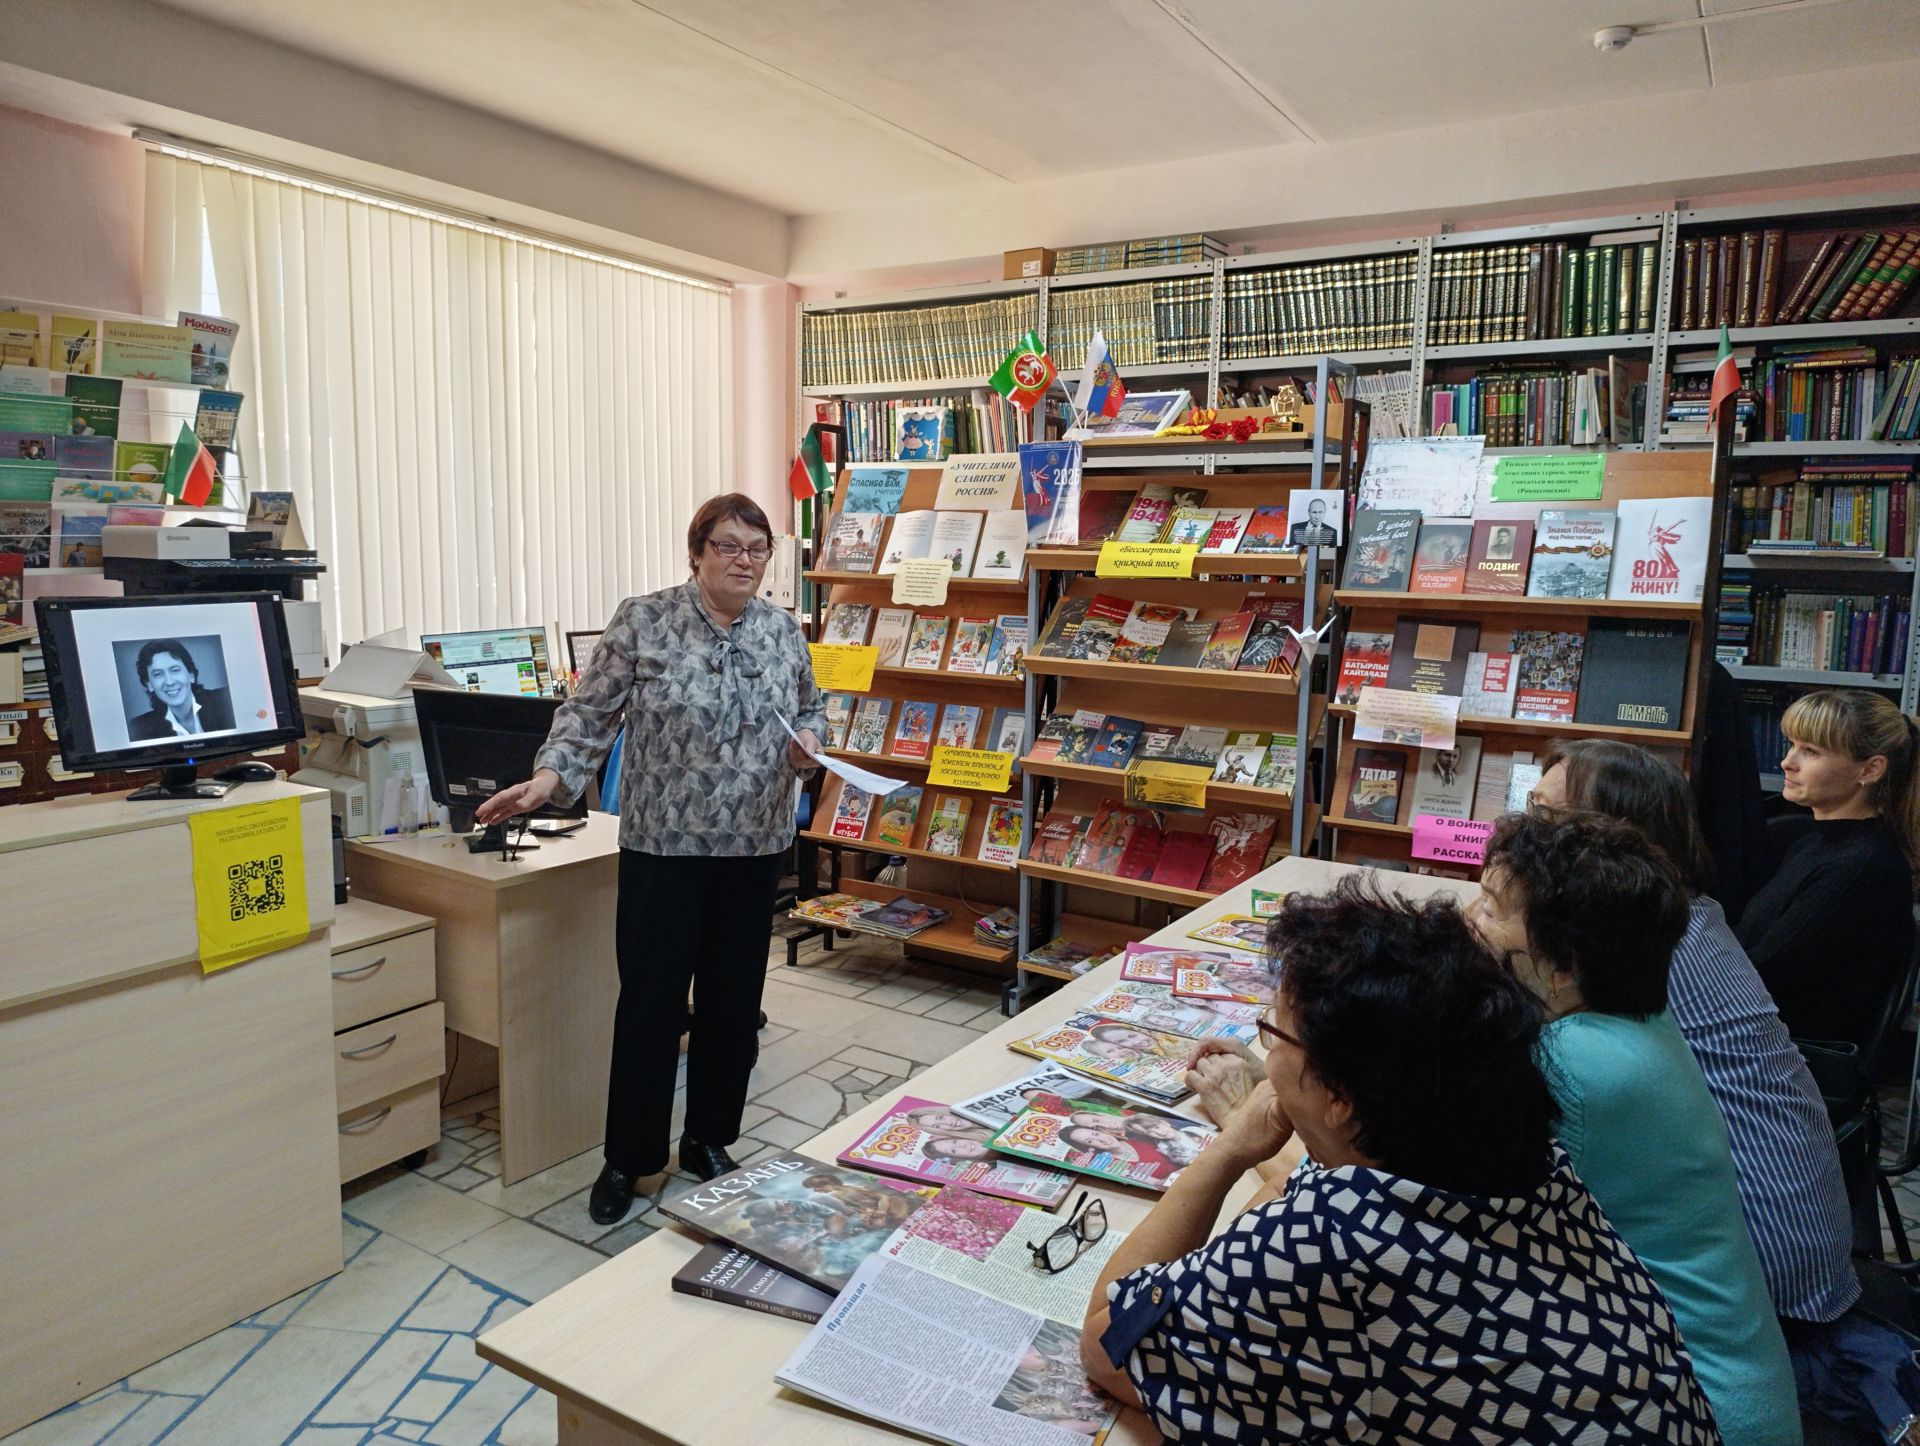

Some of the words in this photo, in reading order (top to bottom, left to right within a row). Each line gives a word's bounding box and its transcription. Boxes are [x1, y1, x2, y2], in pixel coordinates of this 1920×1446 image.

[950, 462, 1017, 471] «УЧИТЕЛЯМИ
[955, 474, 1006, 483] СЛАВИТСЯ
[955, 487, 998, 496] РОССИЯ»
[1134, 497, 1169, 511] 1941
[1129, 509, 1169, 524] 1945
[1546, 526, 1571, 534] Знамя
[1572, 526, 1605, 535] Победы
[1119, 546, 1182, 556] «Бессмертный
[1113, 559, 1153, 569] книжный
[1155, 560, 1180, 570] полк»
[1478, 562, 1521, 572] ПОДВИГ
[1632, 559, 1659, 578] 80
[1521, 696, 1551, 704] ПОМНИТ
[1553, 697, 1570, 705] МИР
[1617, 703, 1669, 724] ПАМЯТЬ
[1360, 767, 1397, 780] ТАТАР
[683, 1159, 804, 1211] КАЗАНЬ
[713, 1266, 737, 1287] ЭХО
[825, 1281, 868, 1332] Пропащая
